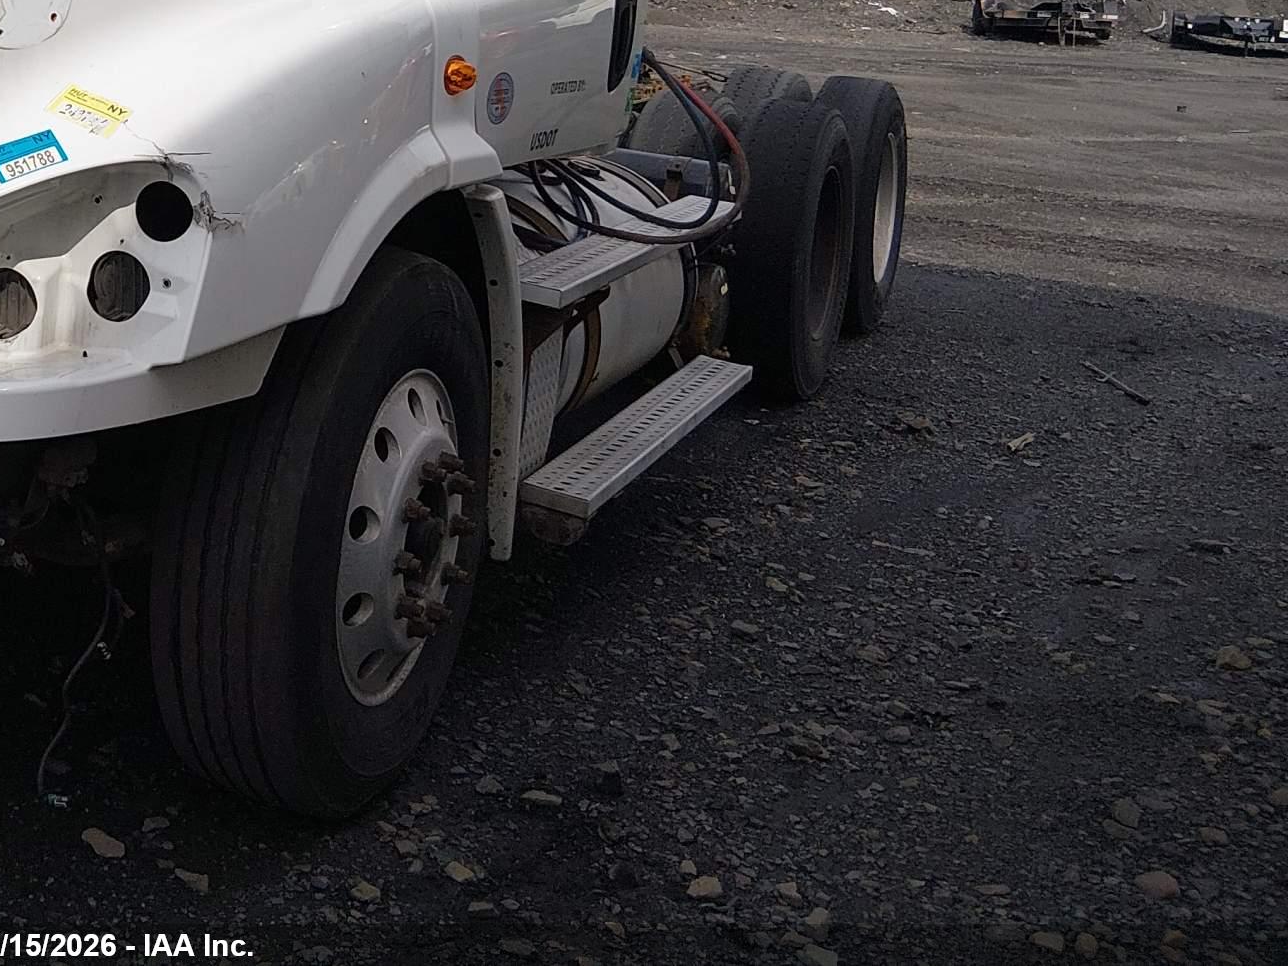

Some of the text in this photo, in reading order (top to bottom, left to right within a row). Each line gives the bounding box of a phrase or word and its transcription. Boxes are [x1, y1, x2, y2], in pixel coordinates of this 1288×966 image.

[107, 104, 128, 116] NY
[32, 131, 51, 144] NY
[530, 128, 559, 151] USDOT
[5, 149, 55, 177] 951788
